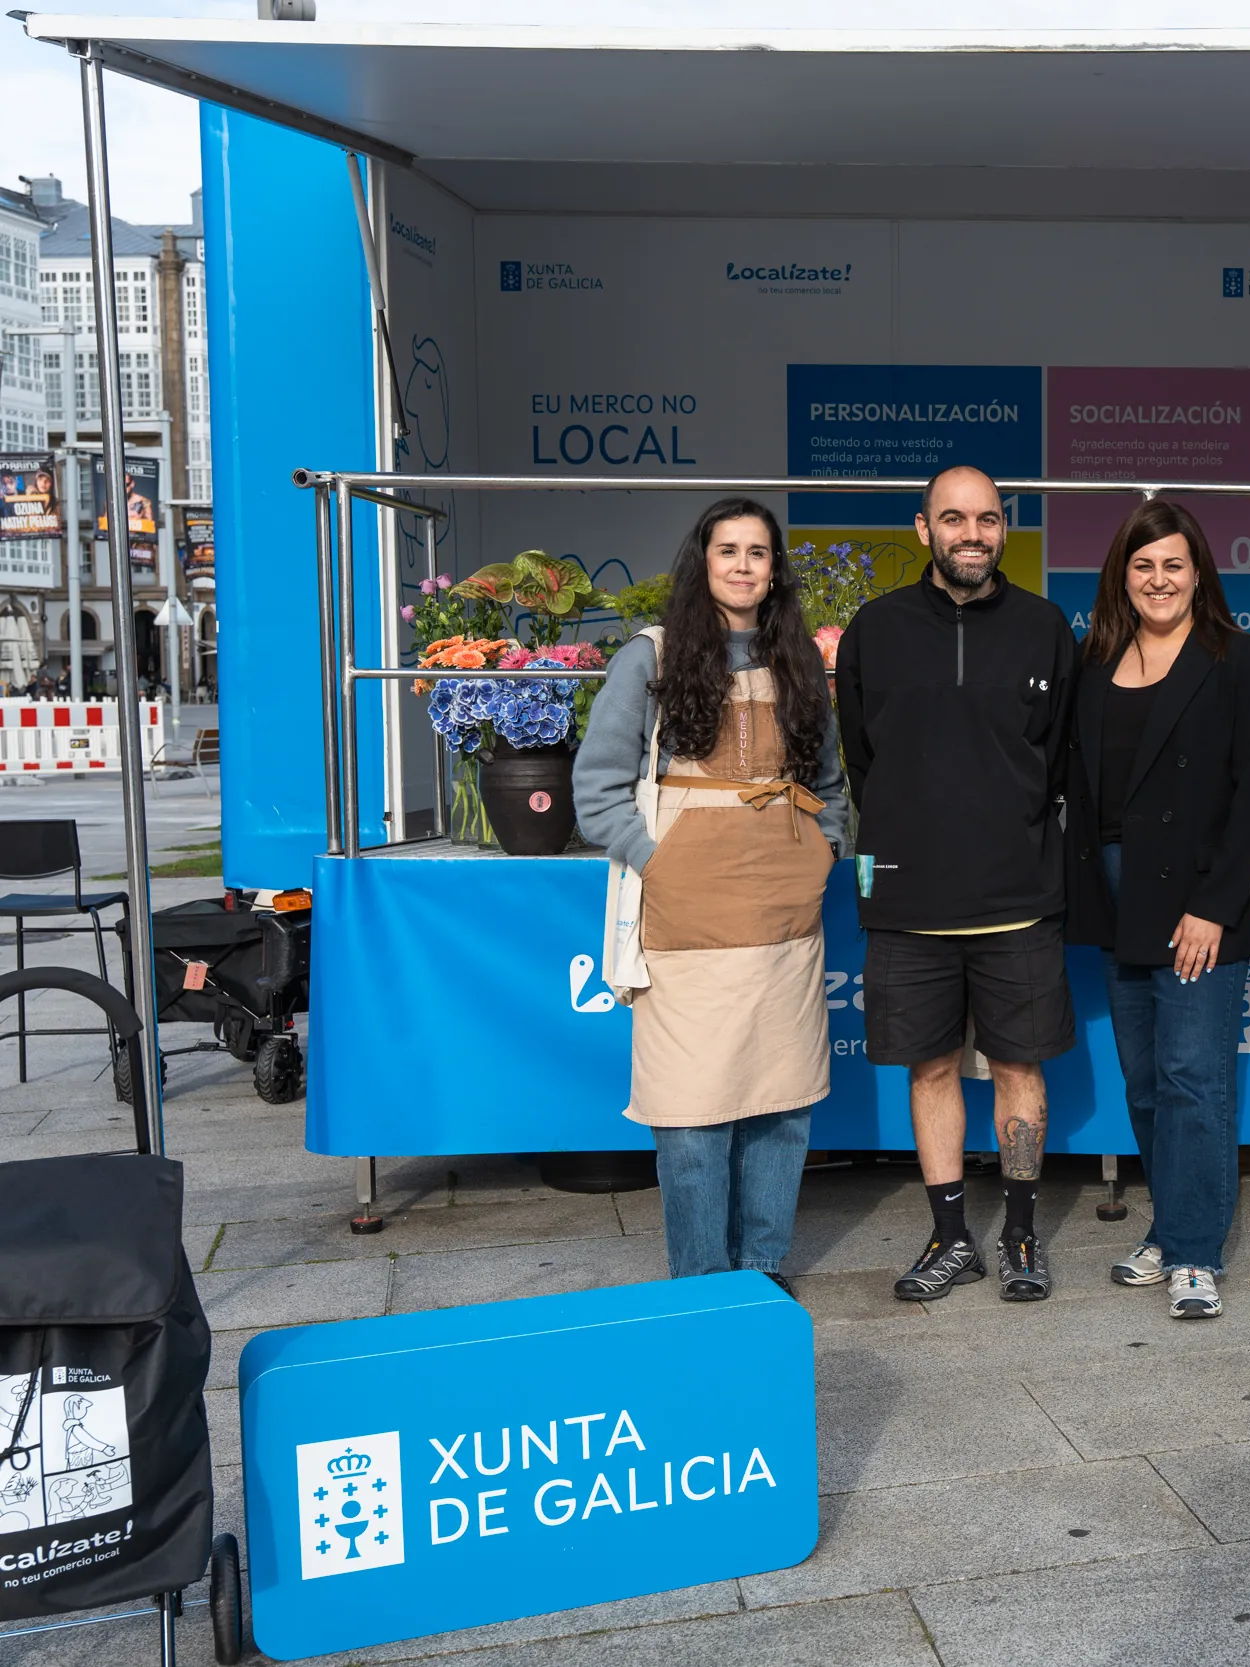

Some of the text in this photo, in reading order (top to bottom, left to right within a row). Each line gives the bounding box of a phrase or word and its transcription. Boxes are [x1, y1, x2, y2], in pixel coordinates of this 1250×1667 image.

[526, 264, 574, 275] XUNTA
[727, 263, 852, 281] Localízate!
[526, 278, 604, 290] DE GALICIA
[770, 287, 783, 295] teu
[785, 286, 821, 295] comercio
[823, 287, 842, 295] local
[532, 394, 697, 414] EU MERCO NO
[810, 399, 1019, 423] PERSONALIZACIÓN
[1069, 401, 1242, 425] SOCIALIZACIÓN
[533, 424, 697, 466] LOCAL
[810, 436, 954, 448] Obtendo o meu vestido a
[1070, 439, 1230, 452] Agradecendo que a tendeira
[811, 452, 939, 465] medida para a voda da
[1070, 455, 1224, 468] sempre me pregunte polos
[811, 467, 878, 477] miña curmá
[1070, 470, 1136, 480] meus netos
[14, 502, 44, 515] OZUNA
[79, 1375, 111, 1383] GALICIA
[428, 1409, 647, 1485] XUNTA
[430, 1447, 777, 1546] DE GALICIA
[0, 1519, 134, 1572] calízate!
[4, 1547, 120, 1588] no teu comercio local
